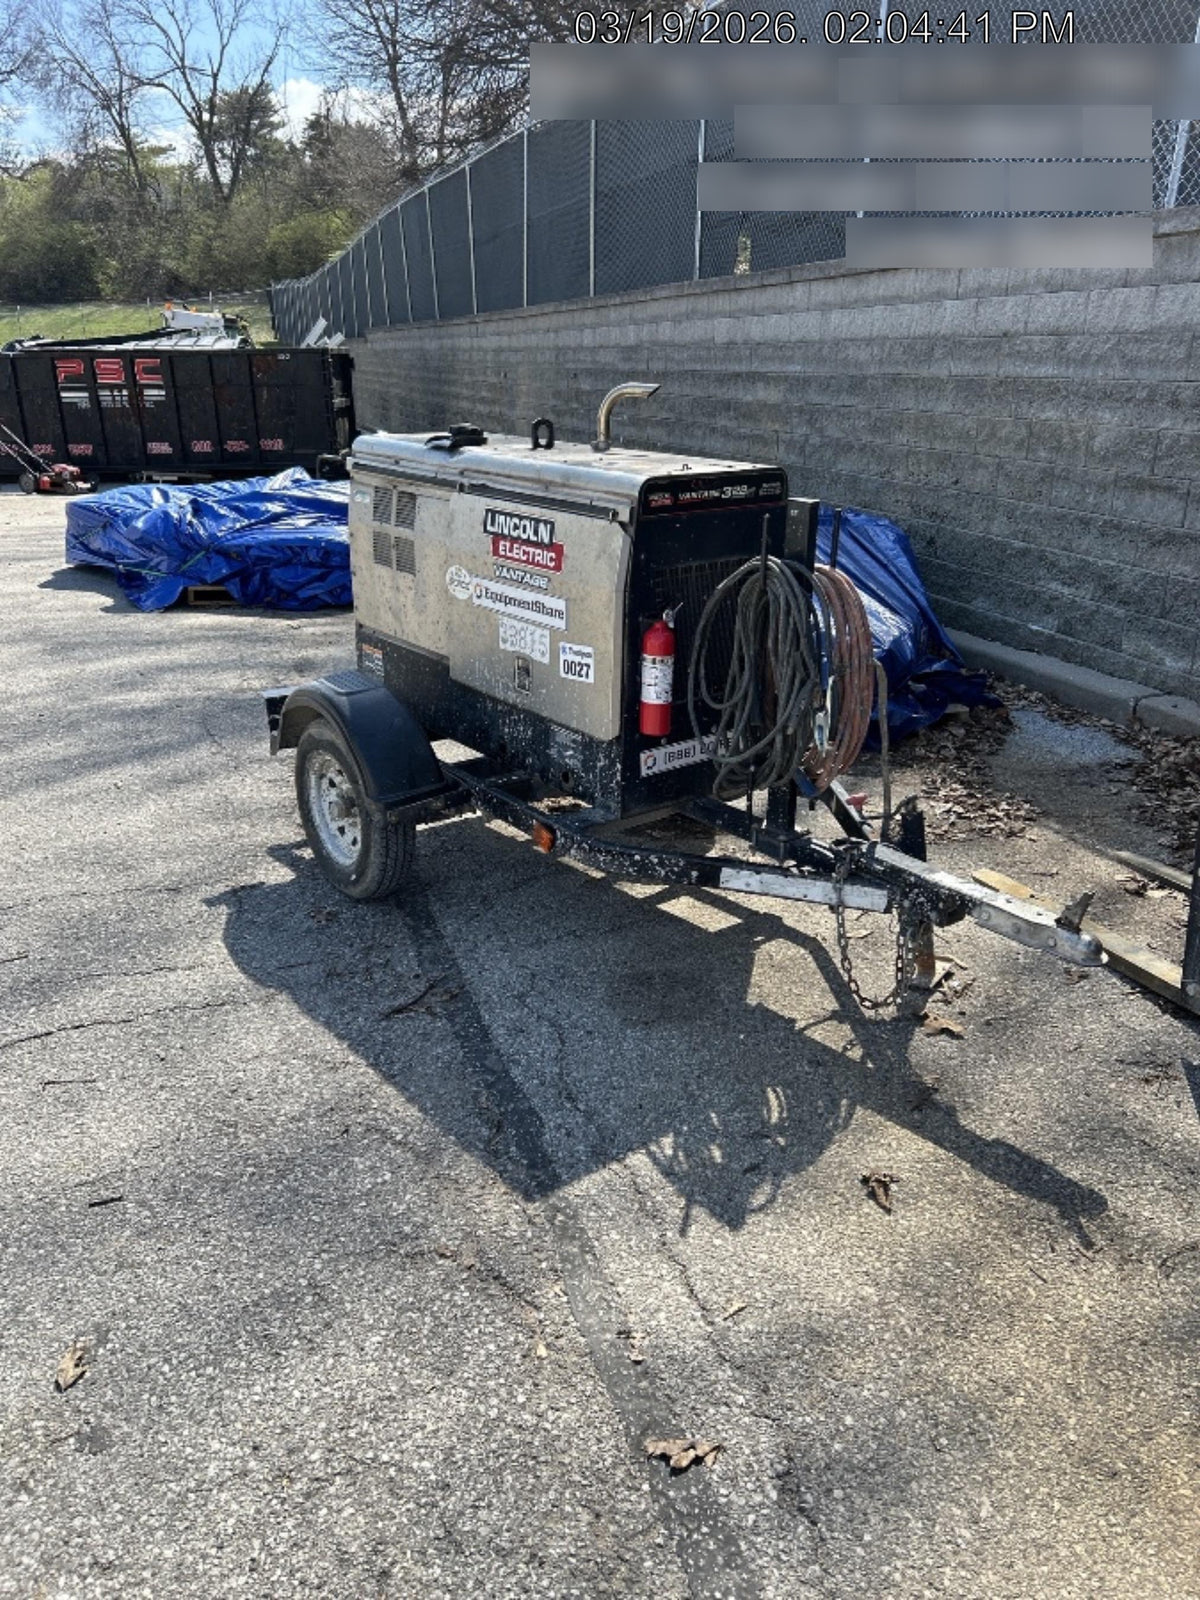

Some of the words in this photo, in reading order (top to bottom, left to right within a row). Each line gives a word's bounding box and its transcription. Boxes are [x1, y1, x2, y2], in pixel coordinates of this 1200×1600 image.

[55, 358, 162, 383] PSC
[485, 511, 552, 545] LINCOLN
[498, 541, 556, 568] ELECTRIC
[493, 564, 549, 590] VANTAGE
[484, 585, 565, 621] EquipmentShare
[563, 659, 591, 680] 0027
